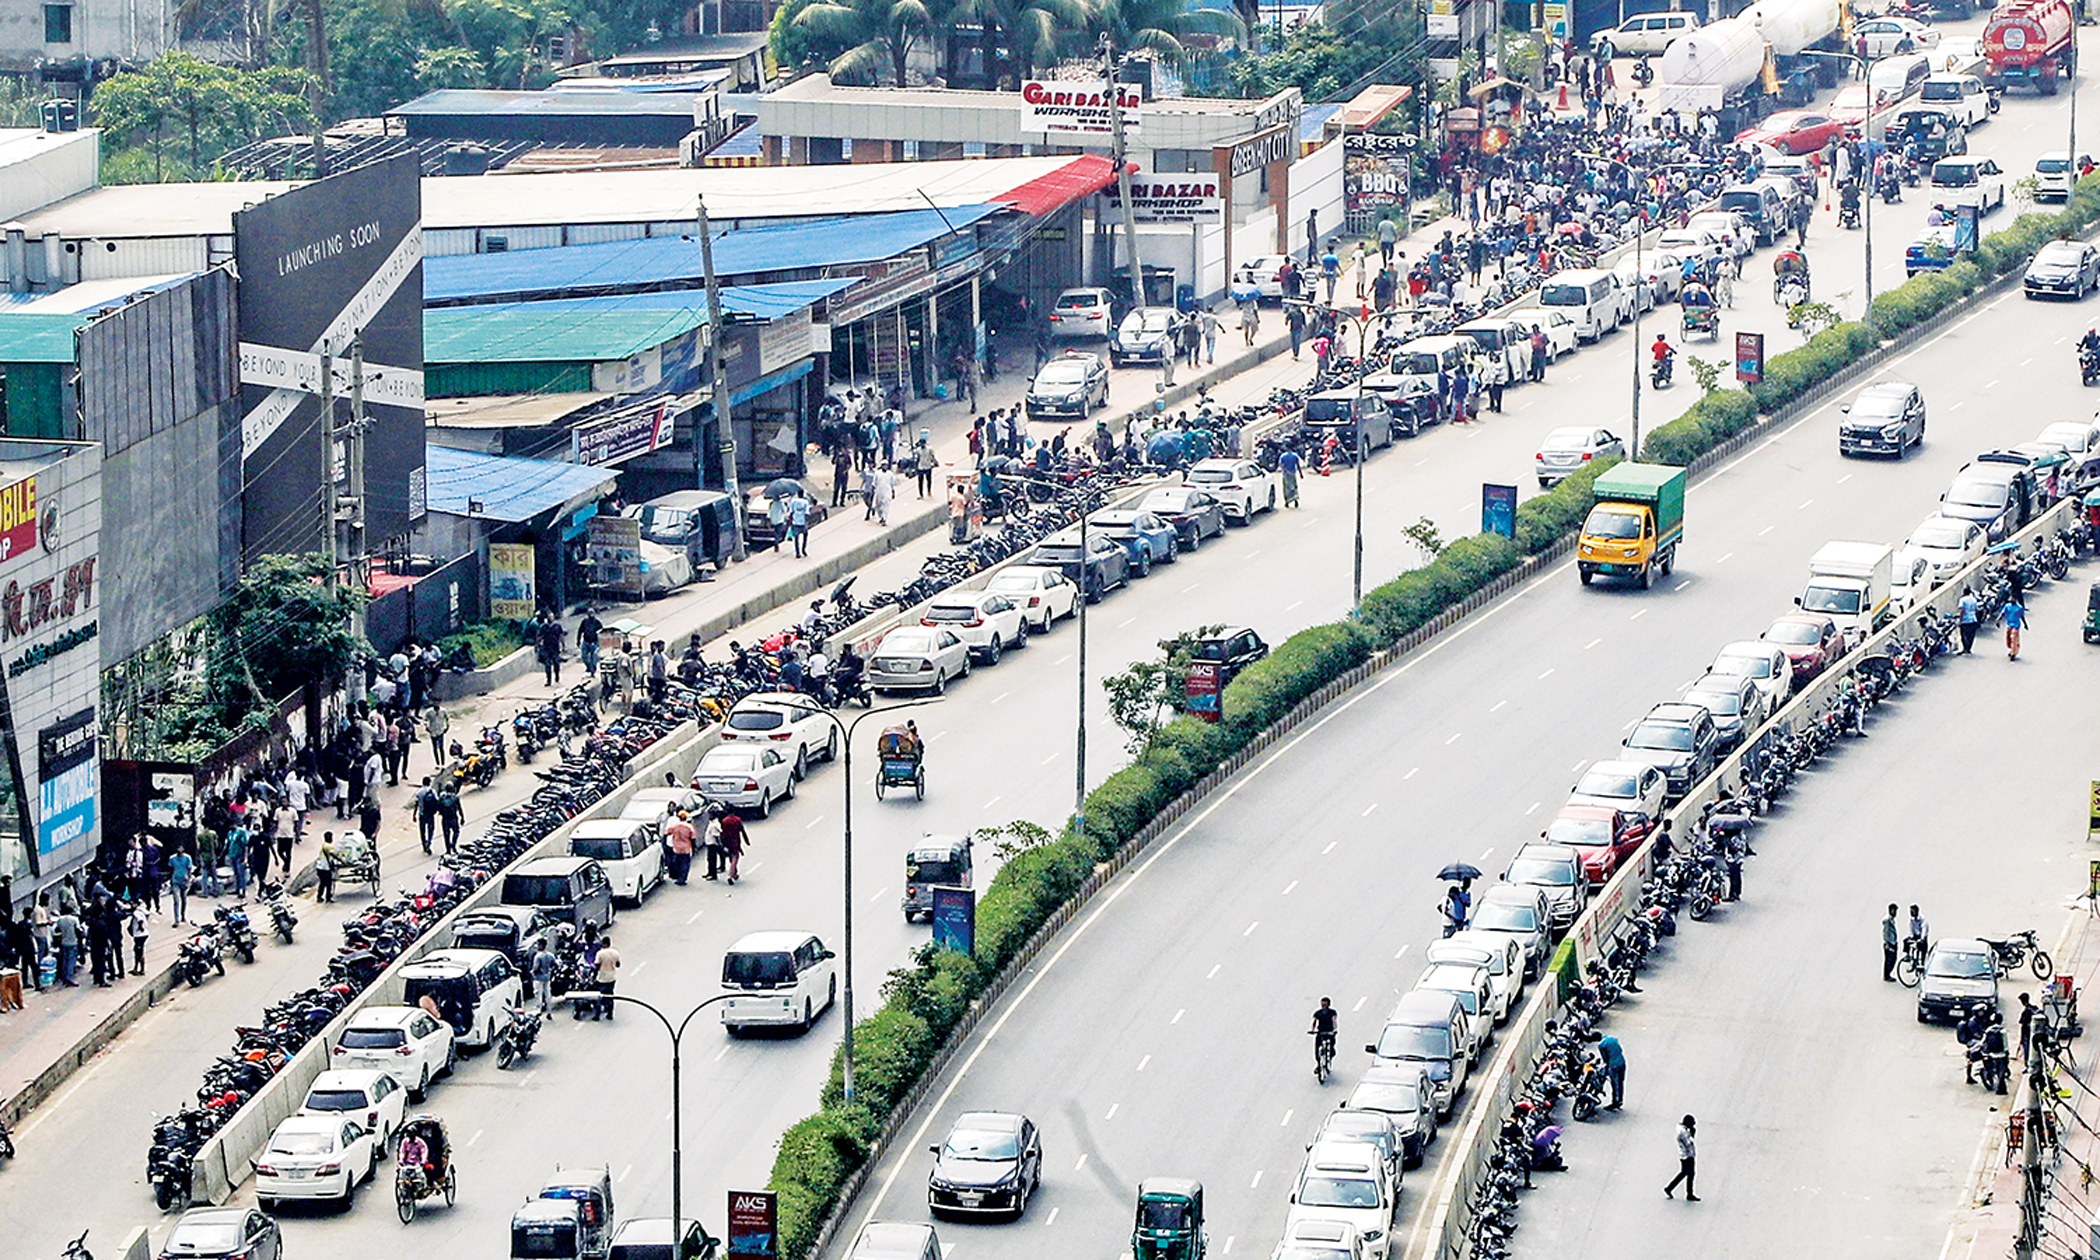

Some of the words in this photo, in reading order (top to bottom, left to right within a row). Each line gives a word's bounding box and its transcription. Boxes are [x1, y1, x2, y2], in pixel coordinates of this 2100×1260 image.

[1023, 82, 1072, 105] GARI
[1152, 183, 1217, 198] BAZAR
[1362, 173, 1397, 194] BBQ
[1111, 198, 1204, 209] WRKSHOP
[278, 233, 344, 277] LAUNCHING
[350, 220, 381, 249] SOON
[243, 354, 287, 377] BEYOND
[293, 362, 316, 381] YOUR
[243, 394, 288, 448] BEYOND
[0, 477, 36, 533] BILE
[735, 1196, 767, 1209] AKS
